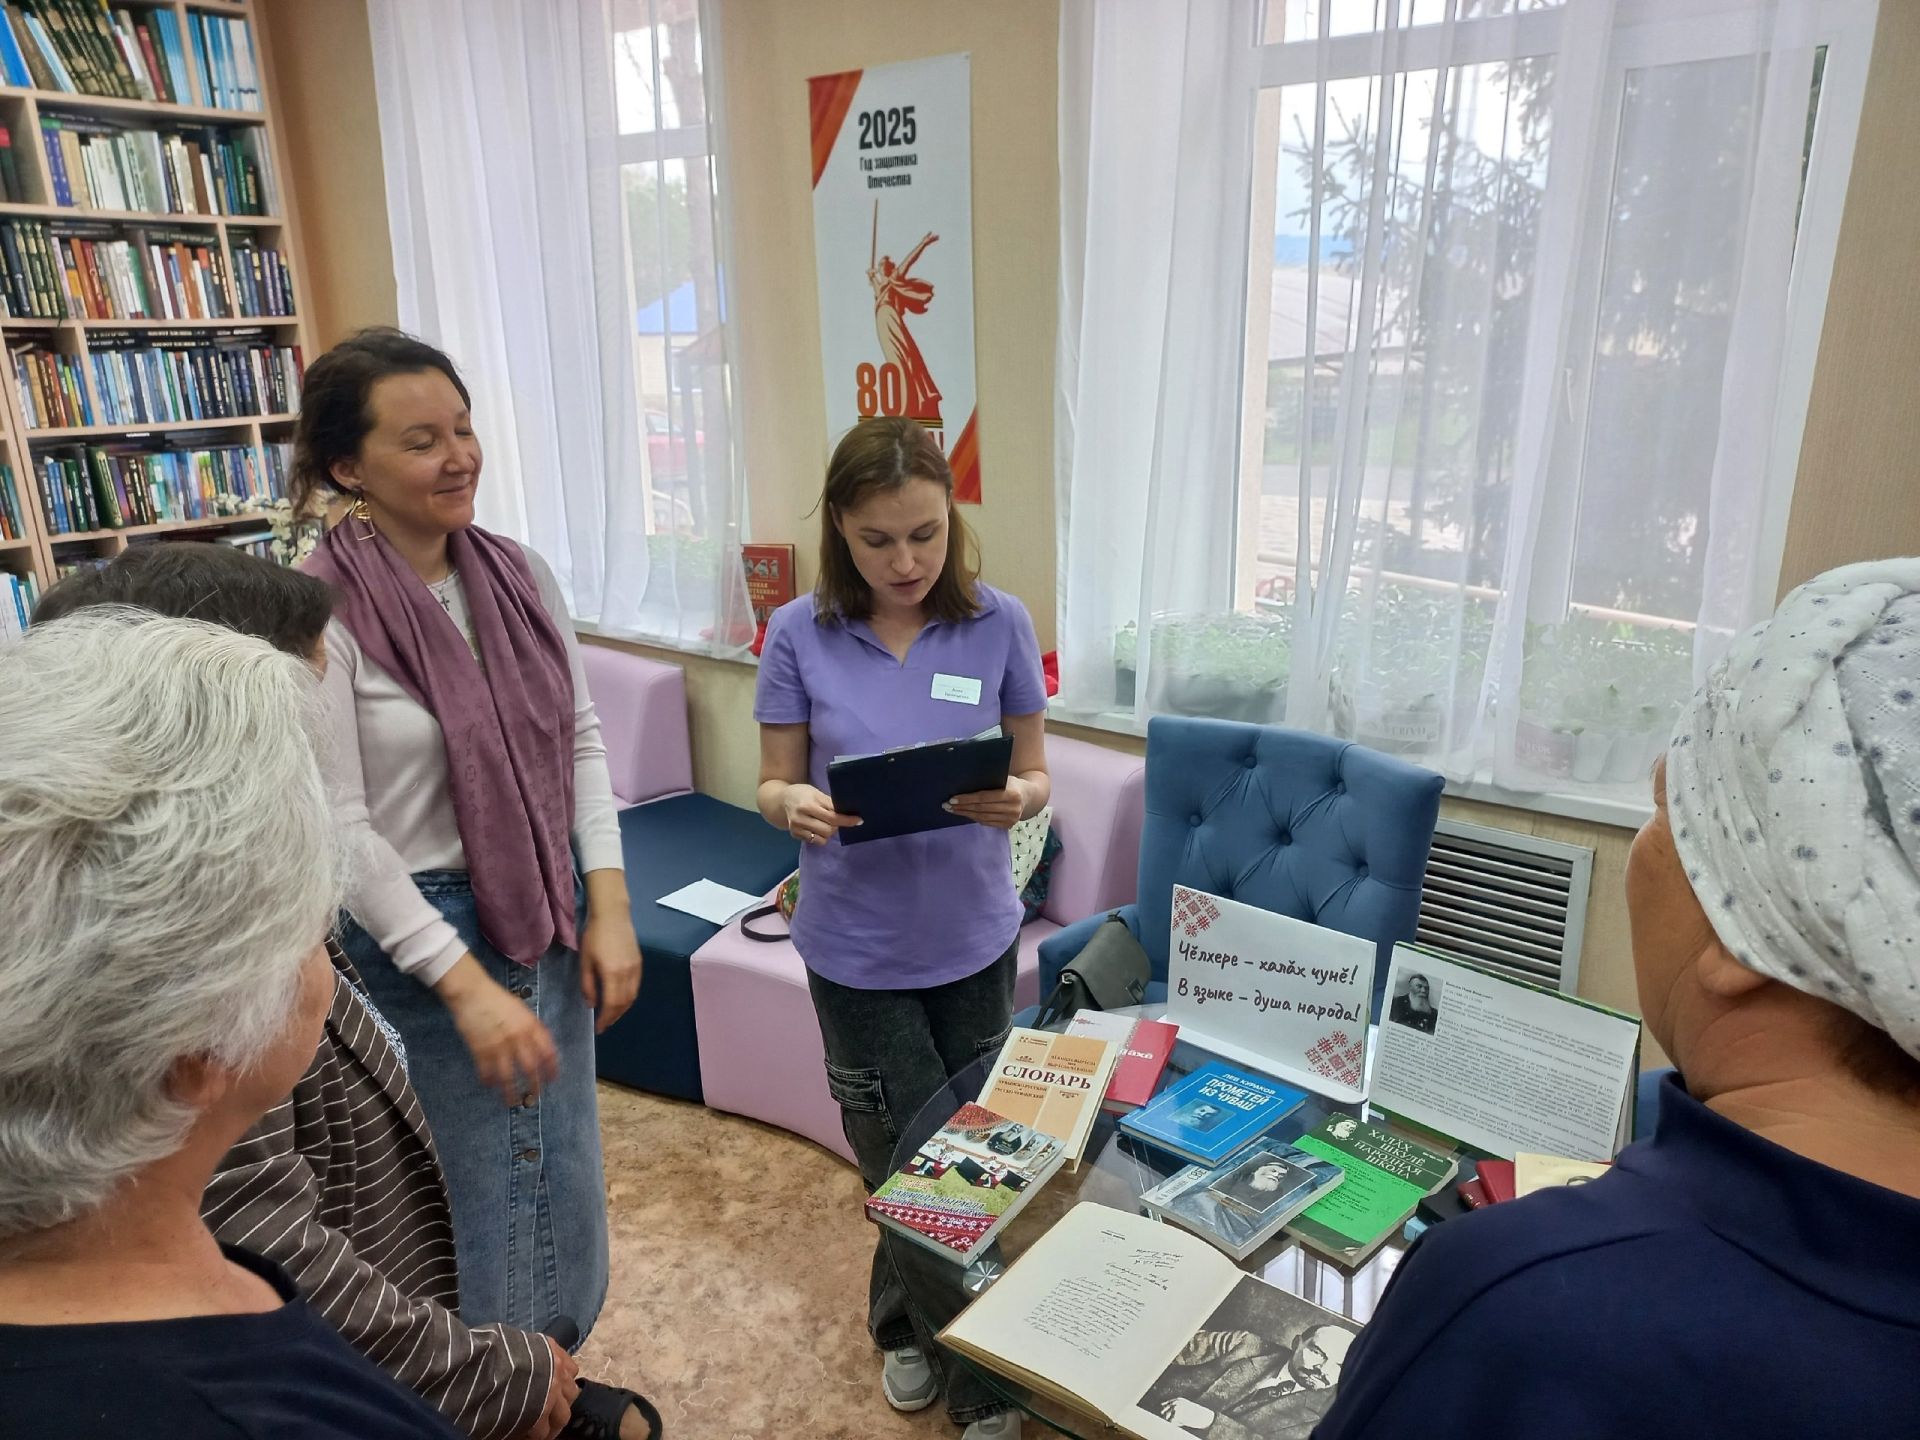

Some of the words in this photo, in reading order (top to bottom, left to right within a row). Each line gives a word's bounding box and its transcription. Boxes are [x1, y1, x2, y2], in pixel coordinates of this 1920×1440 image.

[858, 105, 917, 150] 2025
[860, 156, 873, 171] Год
[874, 154, 918, 169] защитника
[867, 174, 911, 188] Отечества
[856, 362, 902, 416] 80
[1177, 978, 1188, 996] В
[1193, 985, 1233, 1004] языке
[1254, 990, 1291, 1012] душа
[1297, 1003, 1361, 1022] народа!
[1002, 1064, 1091, 1090] СЛОВАРЬ
[1222, 1073, 1240, 1082] ЛЕВ
[1198, 1086, 1218, 1096] ИЗ
[1218, 1092, 1256, 1111] ЧУВАШ
[1205, 1078, 1271, 1105] ПРОМЕТЕЙ
[1354, 1142, 1422, 1175] НАРОДНАЯ
[1366, 1155, 1409, 1179] ШКОЛА
